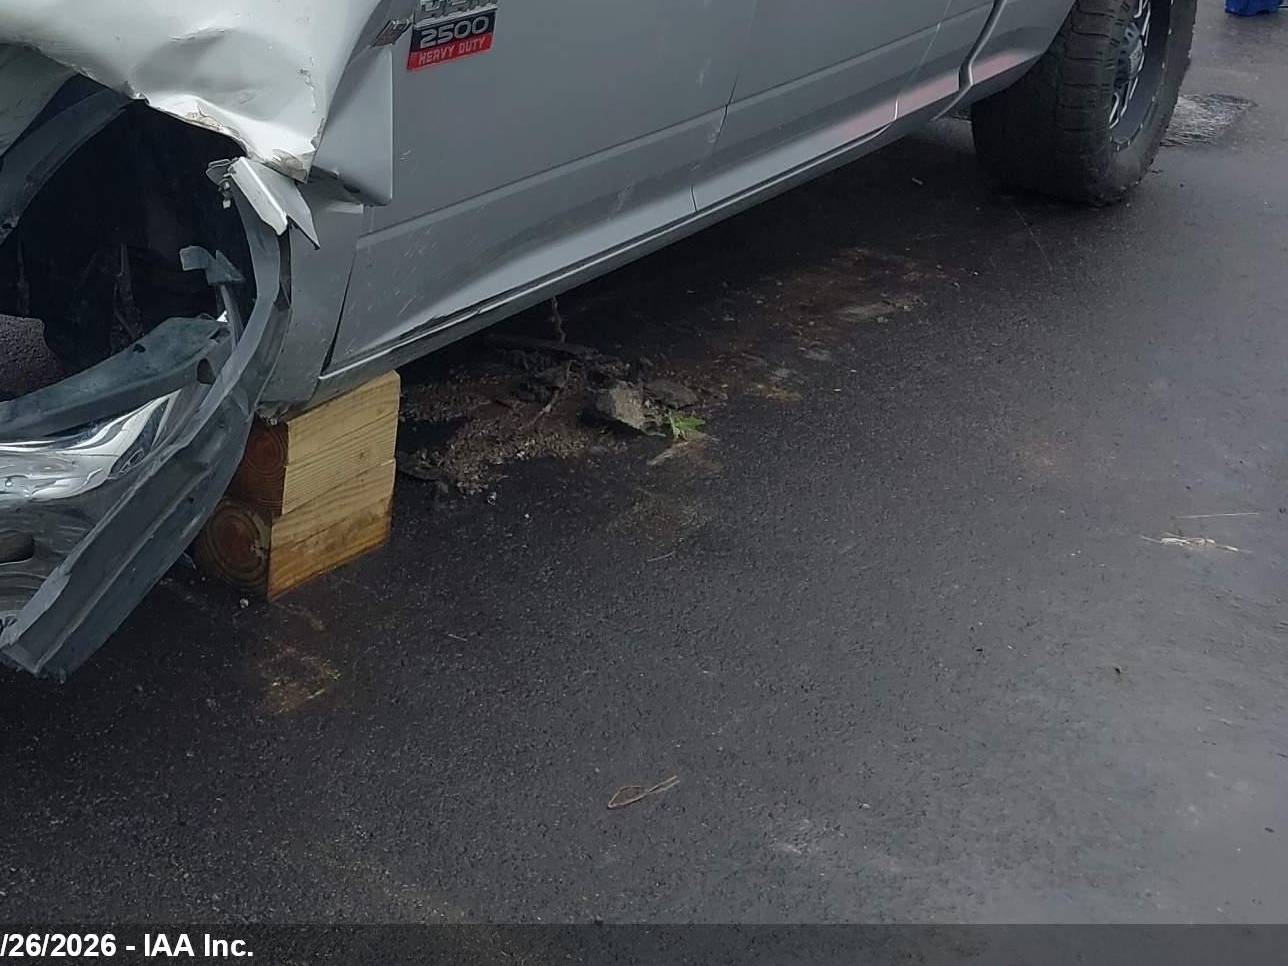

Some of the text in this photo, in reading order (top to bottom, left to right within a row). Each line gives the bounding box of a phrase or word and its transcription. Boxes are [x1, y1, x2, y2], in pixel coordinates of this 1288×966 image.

[420, 16, 489, 49] 2500
[418, 36, 486, 65] HEAVY DUTY
